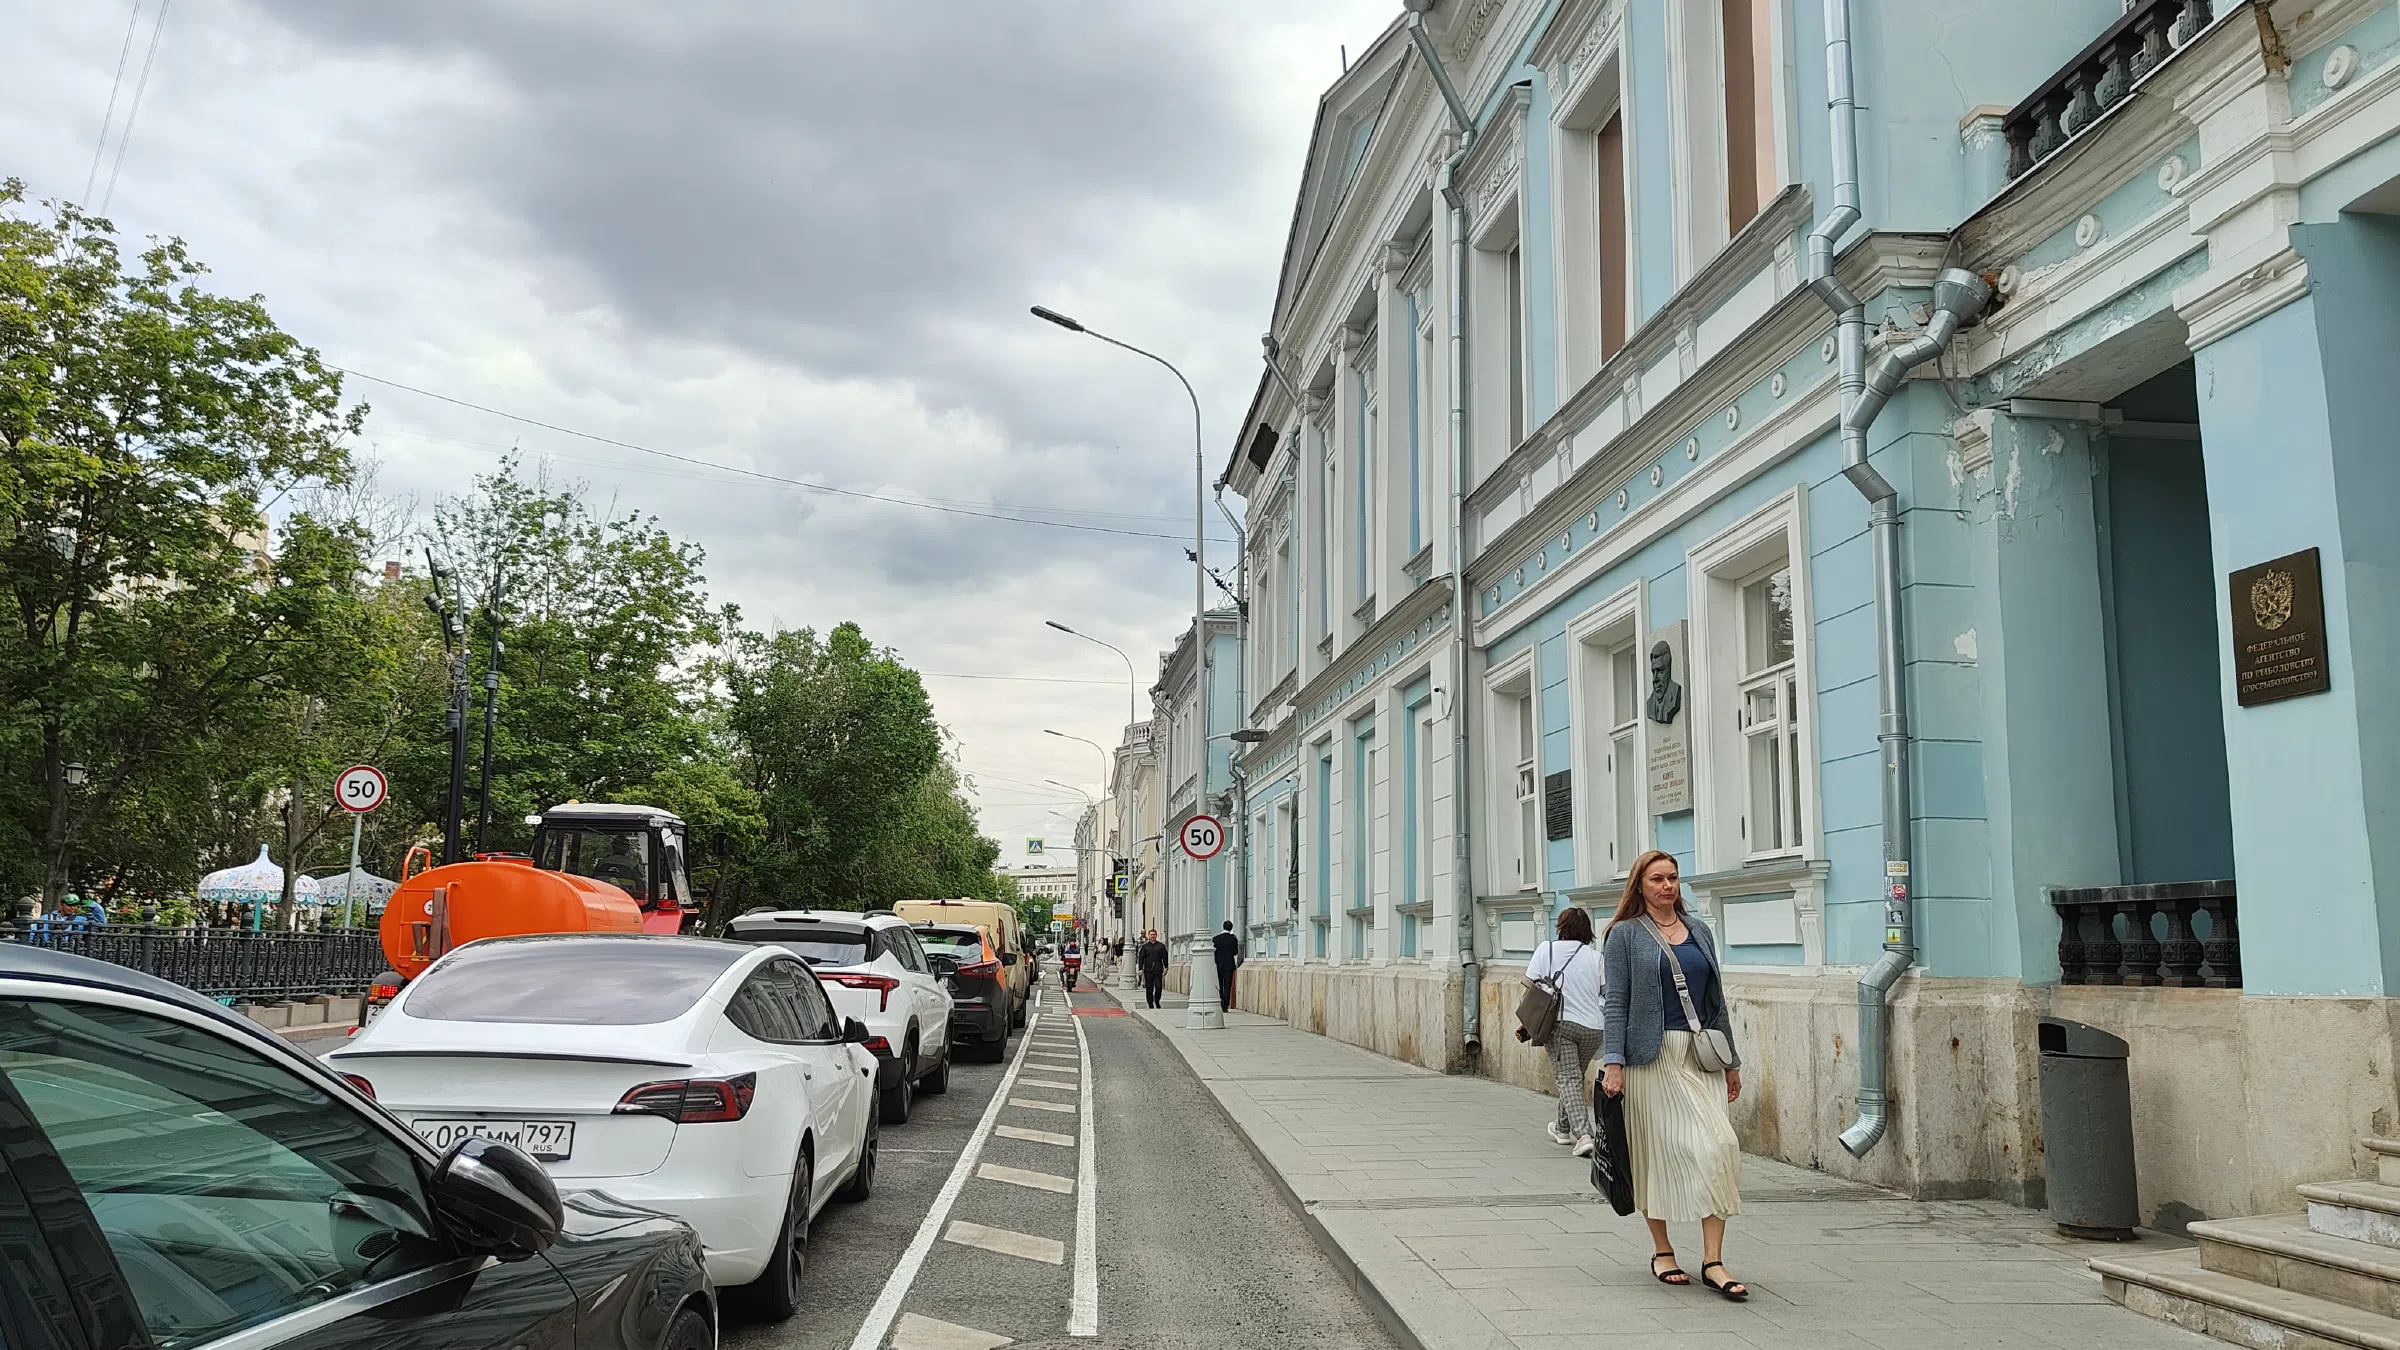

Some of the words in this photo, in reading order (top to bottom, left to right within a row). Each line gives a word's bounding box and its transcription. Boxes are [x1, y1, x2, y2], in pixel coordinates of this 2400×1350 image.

[2247, 632, 2307, 653] ФЕДЕРАЛЬНОЕ
[2255, 648, 2300, 664] АГЕНТСТВО
[2242, 671, 2254, 680] ПО
[2255, 656, 2316, 677] РЫБОЛОВСТВУ
[2243, 671, 2316, 692] (РОСРЫБОЛОВСТВО)
[348, 780, 375, 798] 50
[1191, 829, 1214, 846] 50
[526, 1125, 565, 1143] 797
[532, 1144, 554, 1152] RUS
